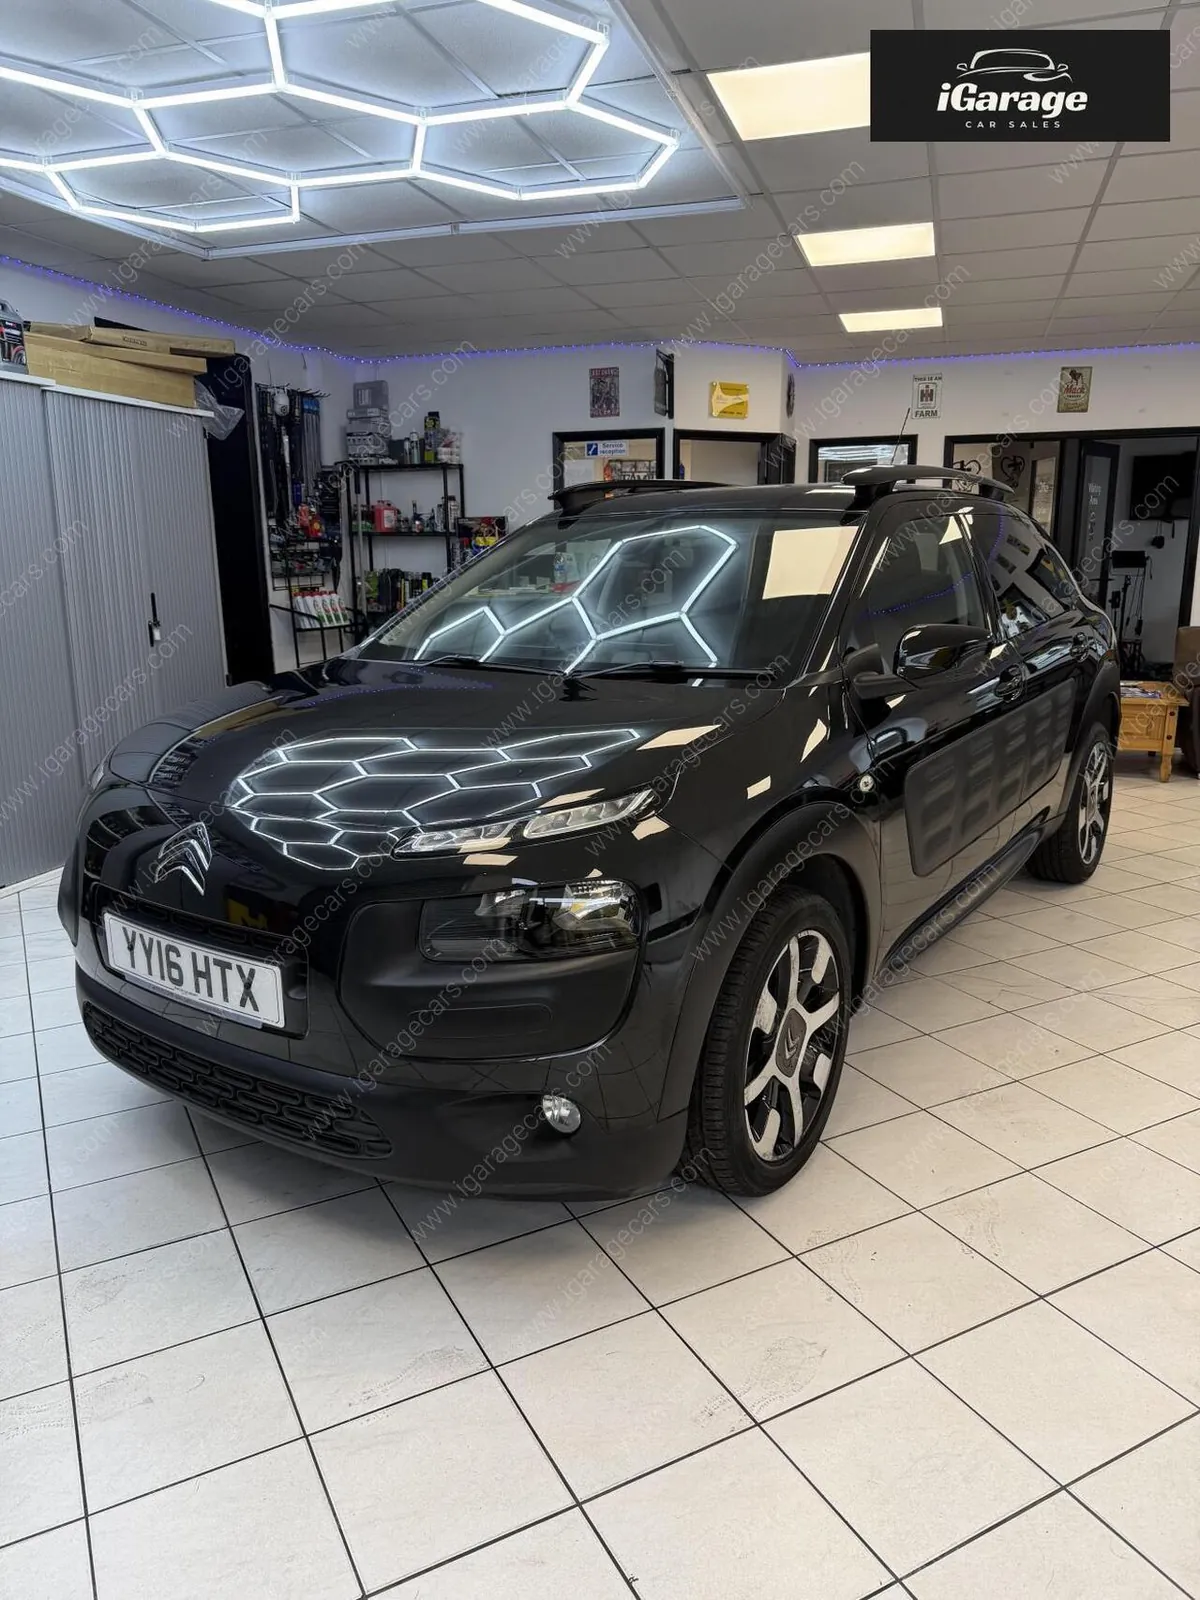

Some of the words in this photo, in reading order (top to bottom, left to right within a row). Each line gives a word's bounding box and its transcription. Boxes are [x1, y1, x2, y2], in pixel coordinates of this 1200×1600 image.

[914, 409, 938, 418] FARM
[599, 448, 626, 456] reception
[122, 925, 185, 986] YY16
[190, 951, 260, 1013] HTX
